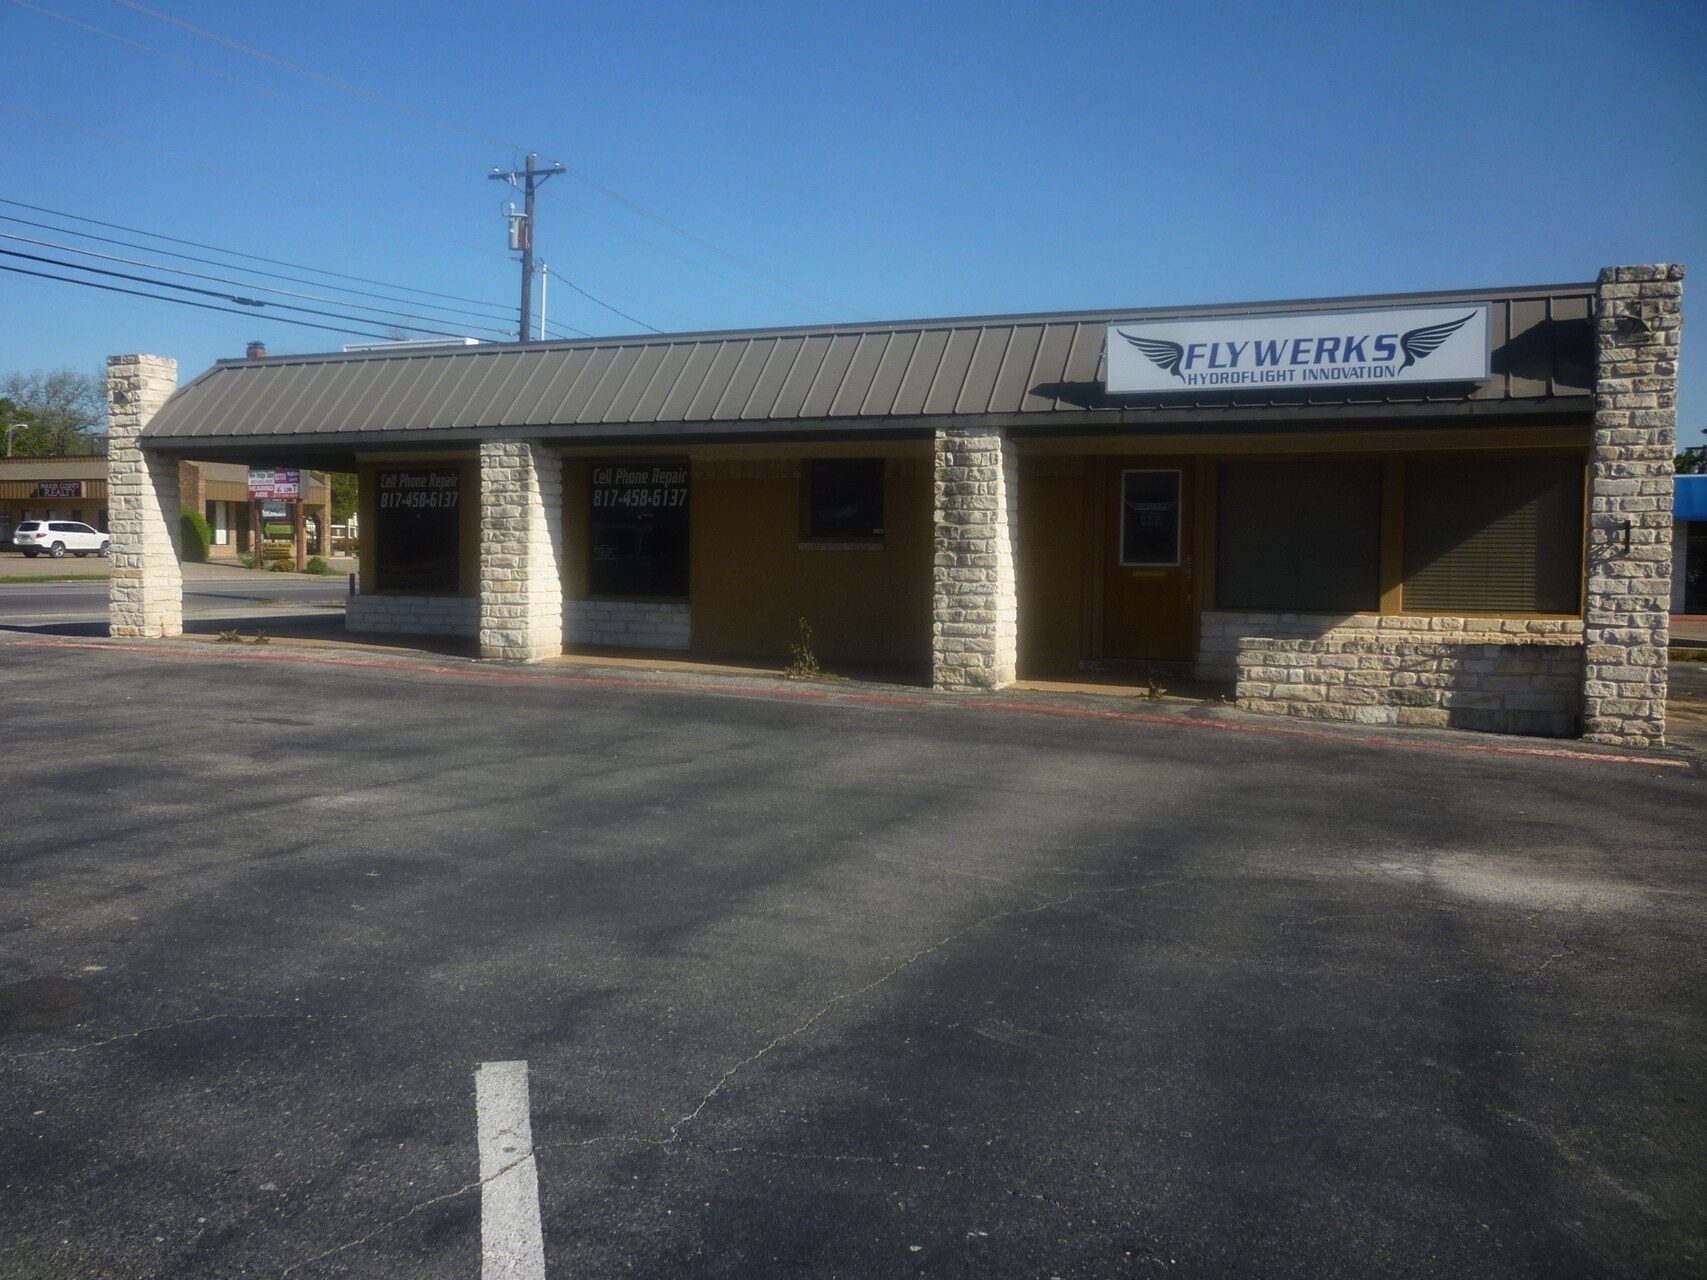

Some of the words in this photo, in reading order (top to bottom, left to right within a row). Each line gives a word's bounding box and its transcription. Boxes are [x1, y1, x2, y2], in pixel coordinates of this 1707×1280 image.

[1183, 334, 1399, 370] FLYWERKS
[1187, 368, 1295, 385] HYDROFLIGHT
[1302, 364, 1396, 381] INNOVATION
[380, 473, 397, 489] Cell
[399, 473, 427, 489] Phone
[429, 472, 459, 491] Repair
[593, 468, 612, 485] Cell
[615, 467, 648, 484] Phone
[652, 467, 688, 488] Repair
[44, 488, 76, 497] REALTY
[593, 488, 688, 506] 817-458-6137
